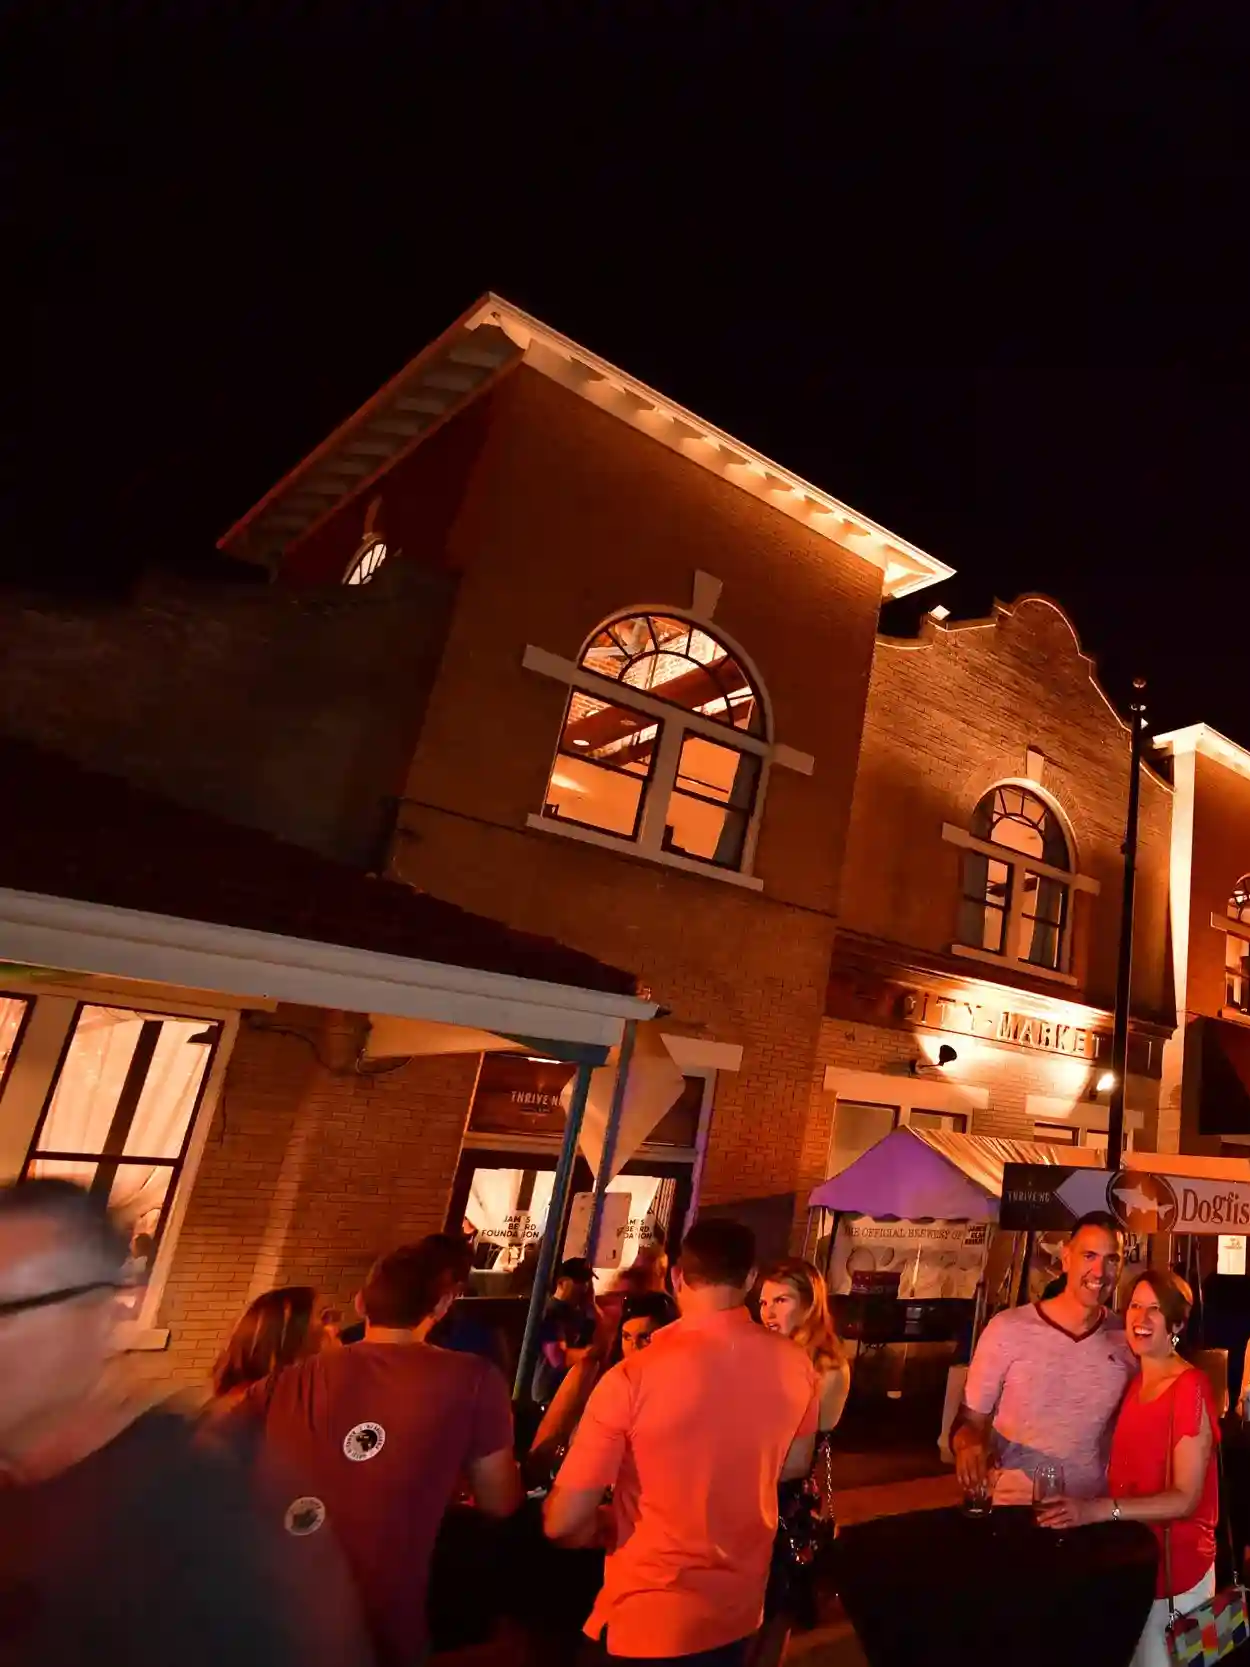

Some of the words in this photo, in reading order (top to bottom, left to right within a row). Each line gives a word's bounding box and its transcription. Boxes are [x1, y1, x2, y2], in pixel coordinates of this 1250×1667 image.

[997, 1011, 1107, 1058] MARKET
[504, 1215, 531, 1223] JAMS
[481, 1229, 539, 1238] FOUNDAION
[862, 1227, 906, 1238] OFFICIAL
